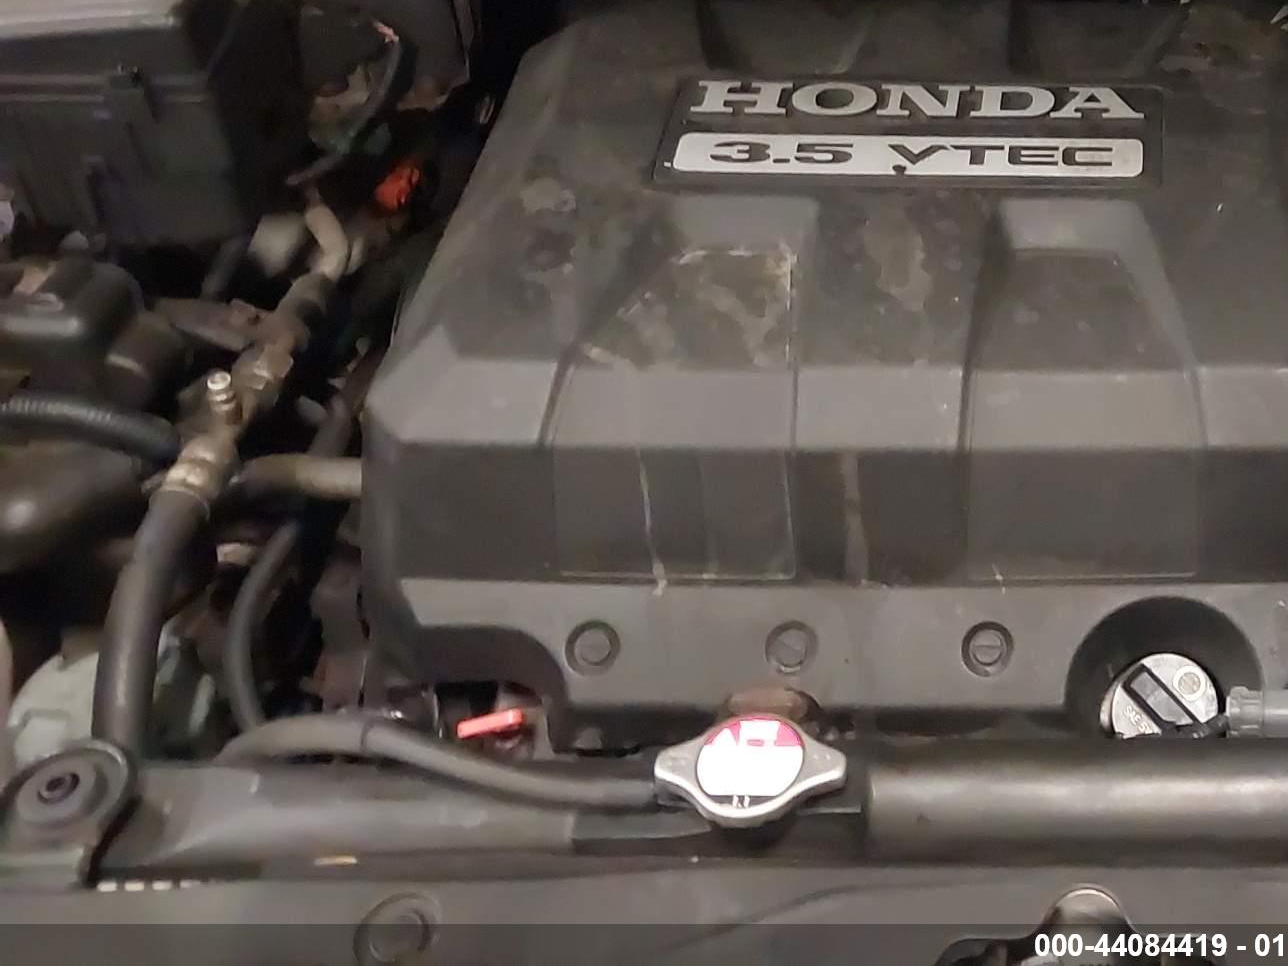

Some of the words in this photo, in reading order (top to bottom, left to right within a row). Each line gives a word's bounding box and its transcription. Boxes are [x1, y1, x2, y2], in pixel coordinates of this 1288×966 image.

[690, 80, 1146, 120] HONDA
[710, 141, 854, 164] 3.5
[887, 143, 1114, 167] VTEC
